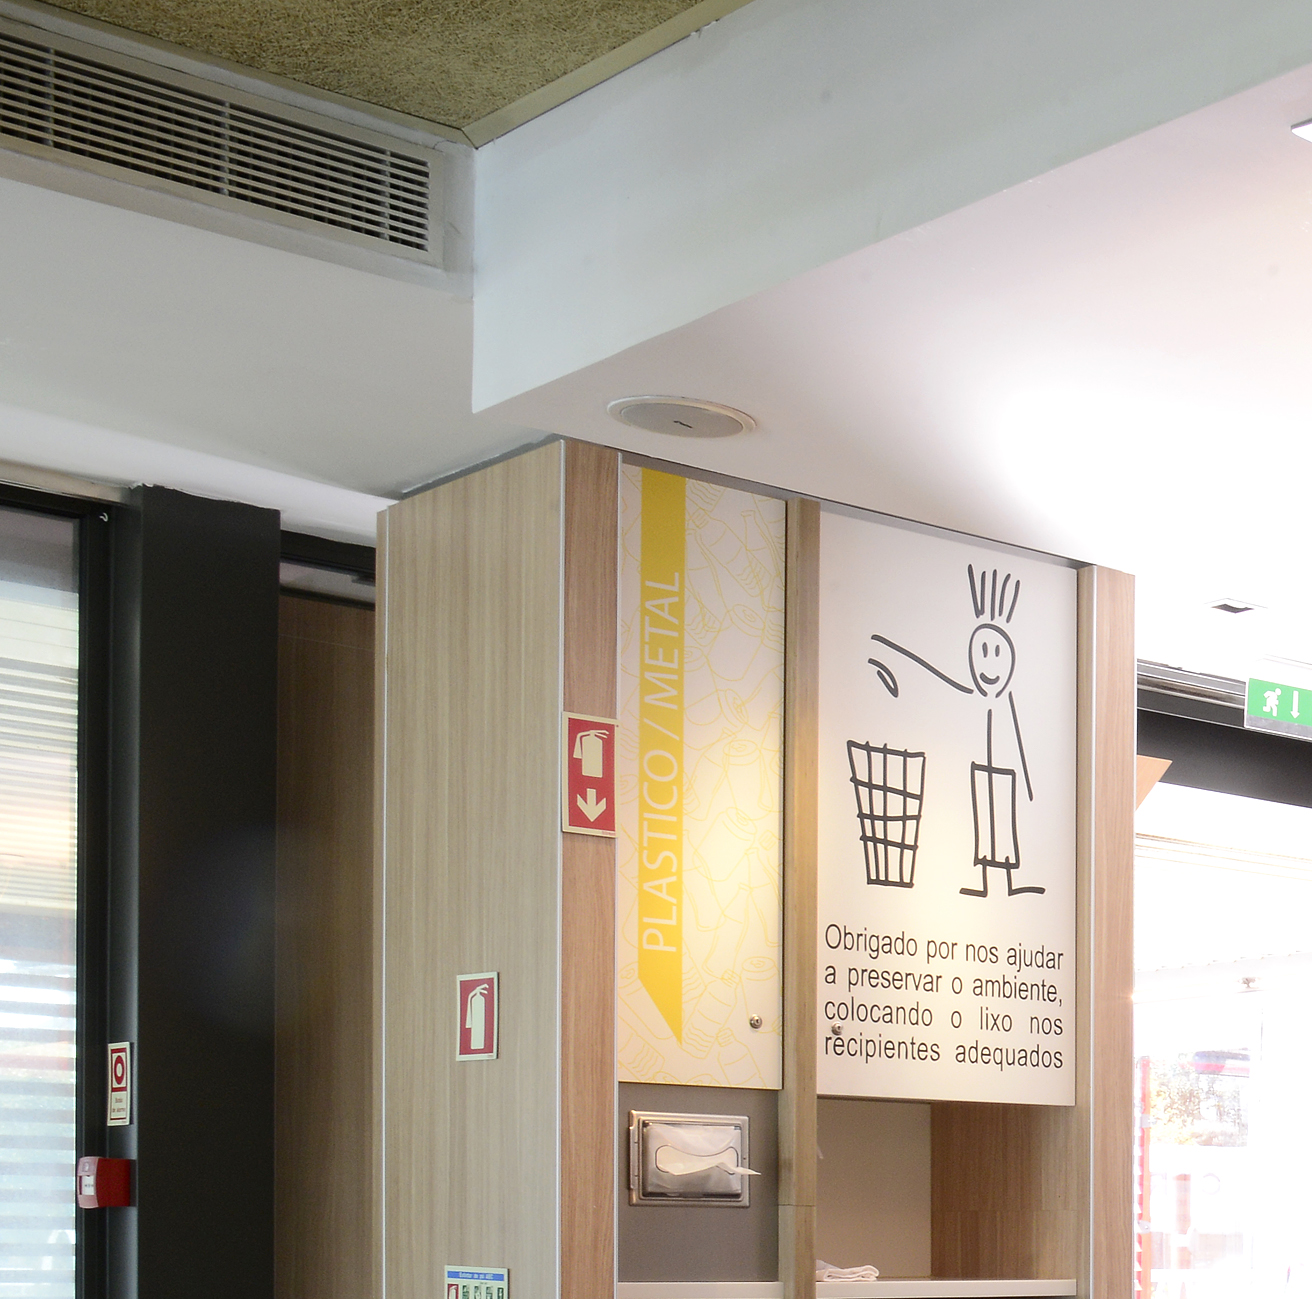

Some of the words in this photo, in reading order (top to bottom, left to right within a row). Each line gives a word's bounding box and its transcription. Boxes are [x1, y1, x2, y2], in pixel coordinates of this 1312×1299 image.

[644, 572, 680, 710] METAL
[642, 749, 679, 953] PLASTICO
[825, 923, 918, 959] Obrigado
[926, 939, 957, 964] por
[965, 943, 999, 964] nos
[1006, 942, 1064, 973] ajudar
[824, 965, 837, 985] a
[848, 966, 943, 993] preservar
[951, 977, 963, 995] o
[972, 974, 1063, 1007] ambiente,
[824, 996, 933, 1027] colocando
[950, 1010, 962, 1029] o
[980, 1006, 1013, 1032] lixo
[1030, 1015, 1063, 1036] nos
[824, 1032, 940, 1064] recipientes
[955, 1040, 1063, 1072] adequados
